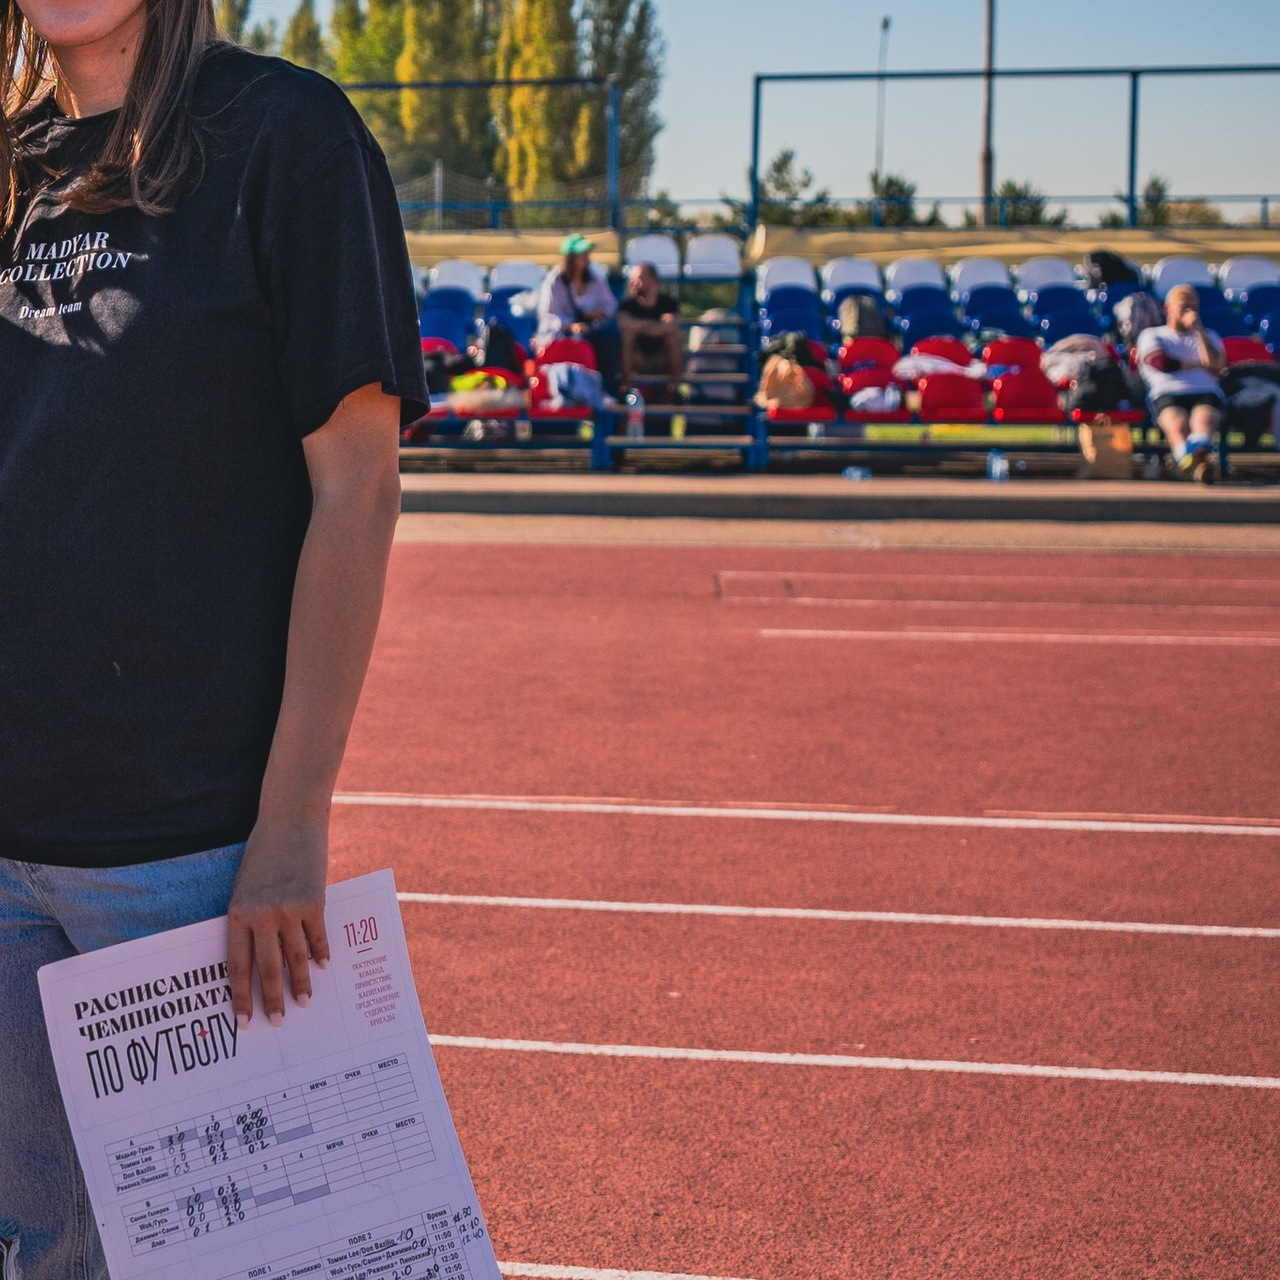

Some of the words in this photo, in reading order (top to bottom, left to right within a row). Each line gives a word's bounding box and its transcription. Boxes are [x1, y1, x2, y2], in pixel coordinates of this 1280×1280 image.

[25, 231, 109, 261] MADYAR
[19, 306, 56, 319] Dream
[343, 916, 378, 948] 11:20
[74, 961, 230, 1020] РАСПИСАНИЕ
[79, 984, 233, 1042] ЧЕМПИОНАТА
[86, 1045, 124, 1099] ПО
[126, 1012, 239, 1085] ФУТБОЛУ
[377, 1058, 399, 1069] МЕСТО
[344, 1069, 362, 1080] ОЧКИ
[309, 1080, 328, 1091] МЯЧИ
[395, 1117, 416, 1129] МЕСТО
[361, 1129, 378, 1140] ОЧКИ
[326, 1140, 344, 1151] МЯЧИ
[120, 1159, 141, 1170] Томми
[141, 1156, 153, 1164] Lee
[123, 1172, 136, 1180] Don
[426, 1209, 447, 1220] Время
[431, 1220, 448, 1231] 11:30
[348, 1234, 367, 1246] ПОЛЕ
[434, 1230, 452, 1241] 11:50
[437, 1241, 455, 1252] 12:10
[327, 1255, 348, 1265] Томми
[441, 1252, 459, 1263] 12:30
[248, 1267, 267, 1279] ПОЛЕ
[444, 1262, 462, 1274] 12:50
